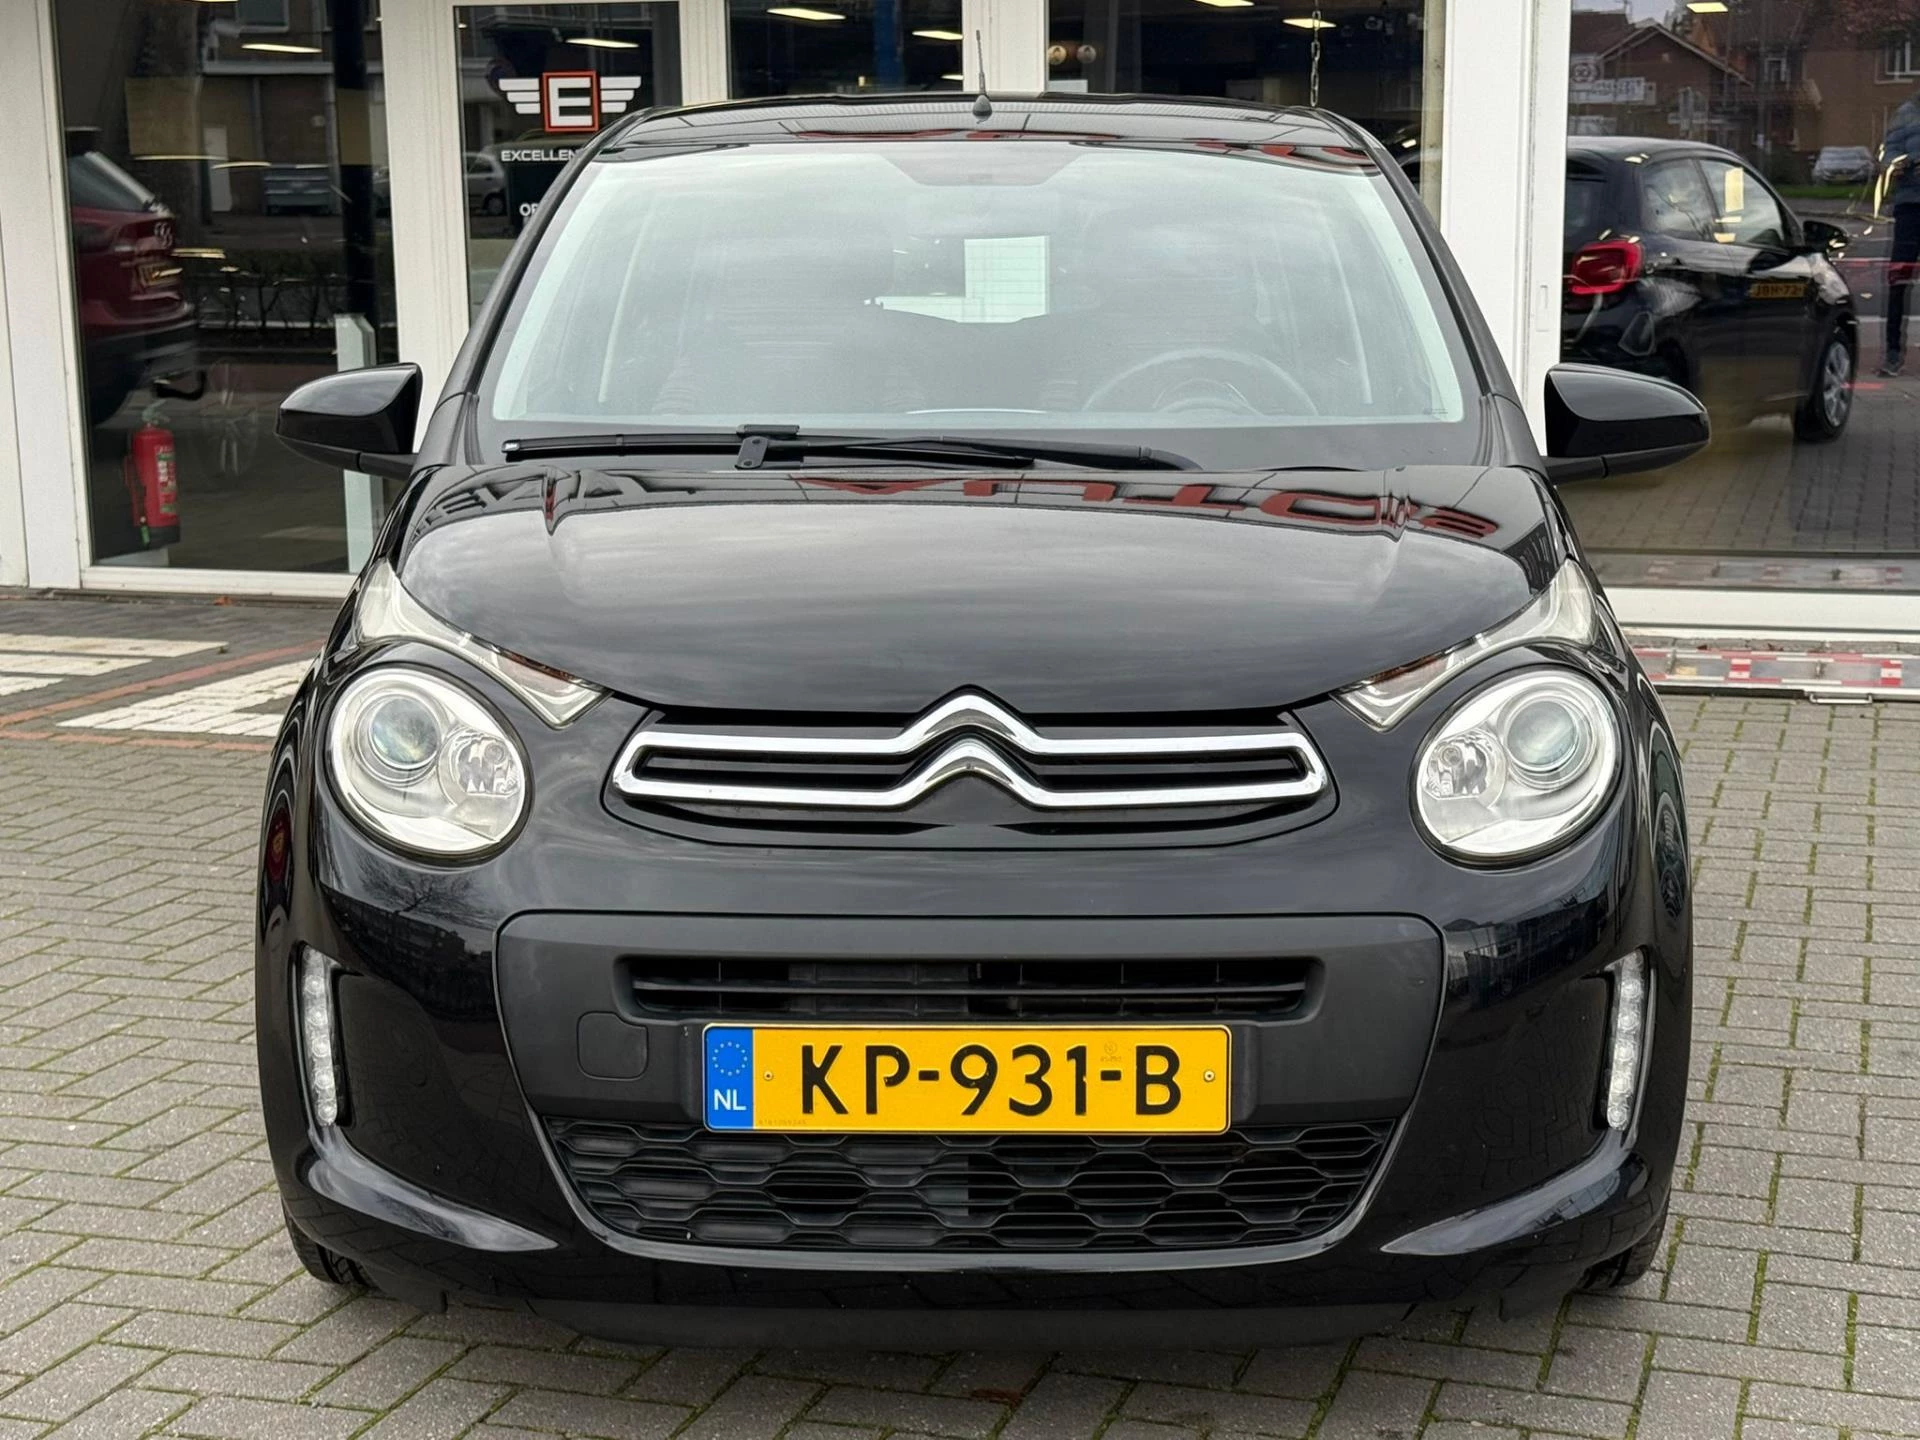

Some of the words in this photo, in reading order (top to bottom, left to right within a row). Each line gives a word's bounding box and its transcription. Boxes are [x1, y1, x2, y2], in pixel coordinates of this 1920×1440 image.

[548, 77, 593, 127] E
[713, 1090, 747, 1111] NL
[802, 1044, 1182, 1117] KP-931-B
